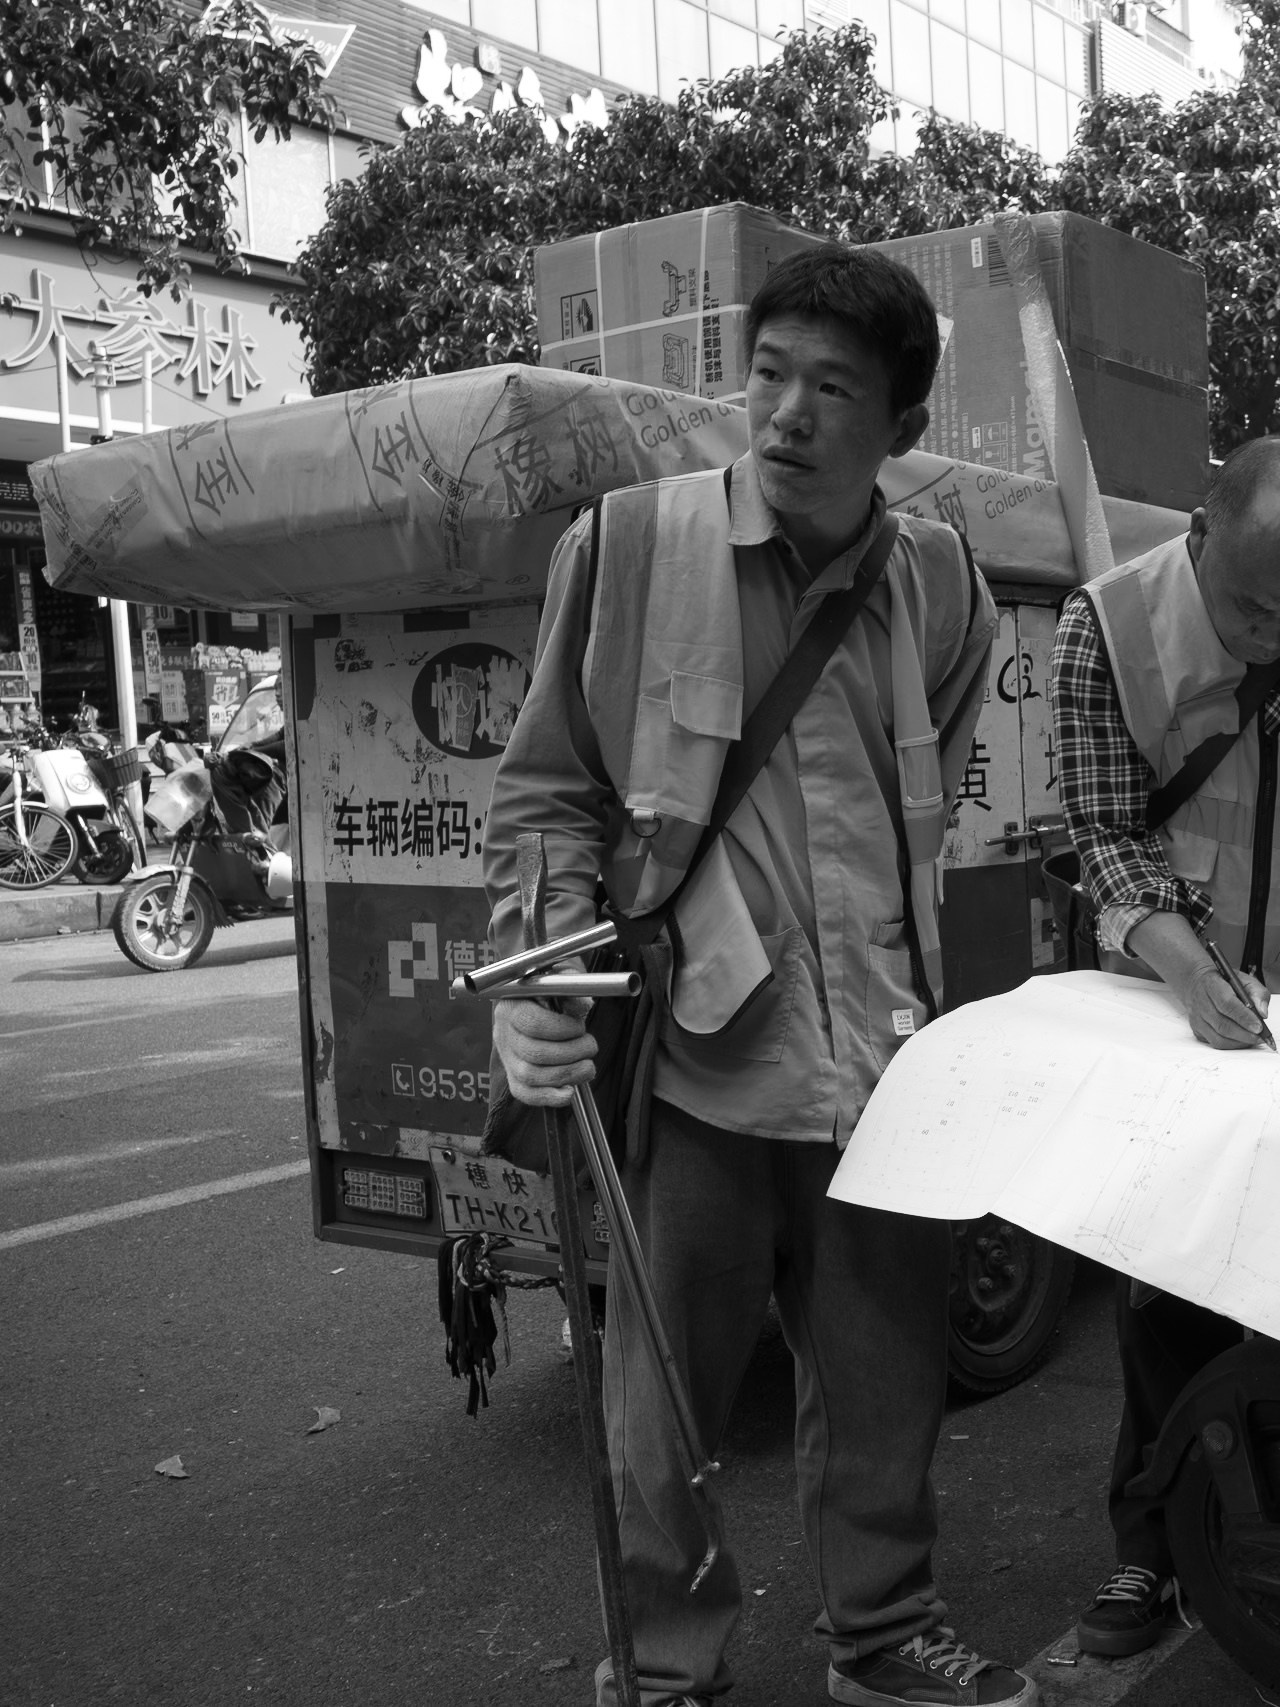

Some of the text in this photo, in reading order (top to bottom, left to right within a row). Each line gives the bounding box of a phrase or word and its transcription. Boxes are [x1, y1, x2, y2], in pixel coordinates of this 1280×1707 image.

[1, 268, 265, 399] 大参林
[641, 406, 713, 448] Golden
[985, 485, 1032, 519] Golden
[23, 626, 35, 637] 20
[26, 653, 37, 665] 10
[334, 797, 482, 858] 车辆编码:
